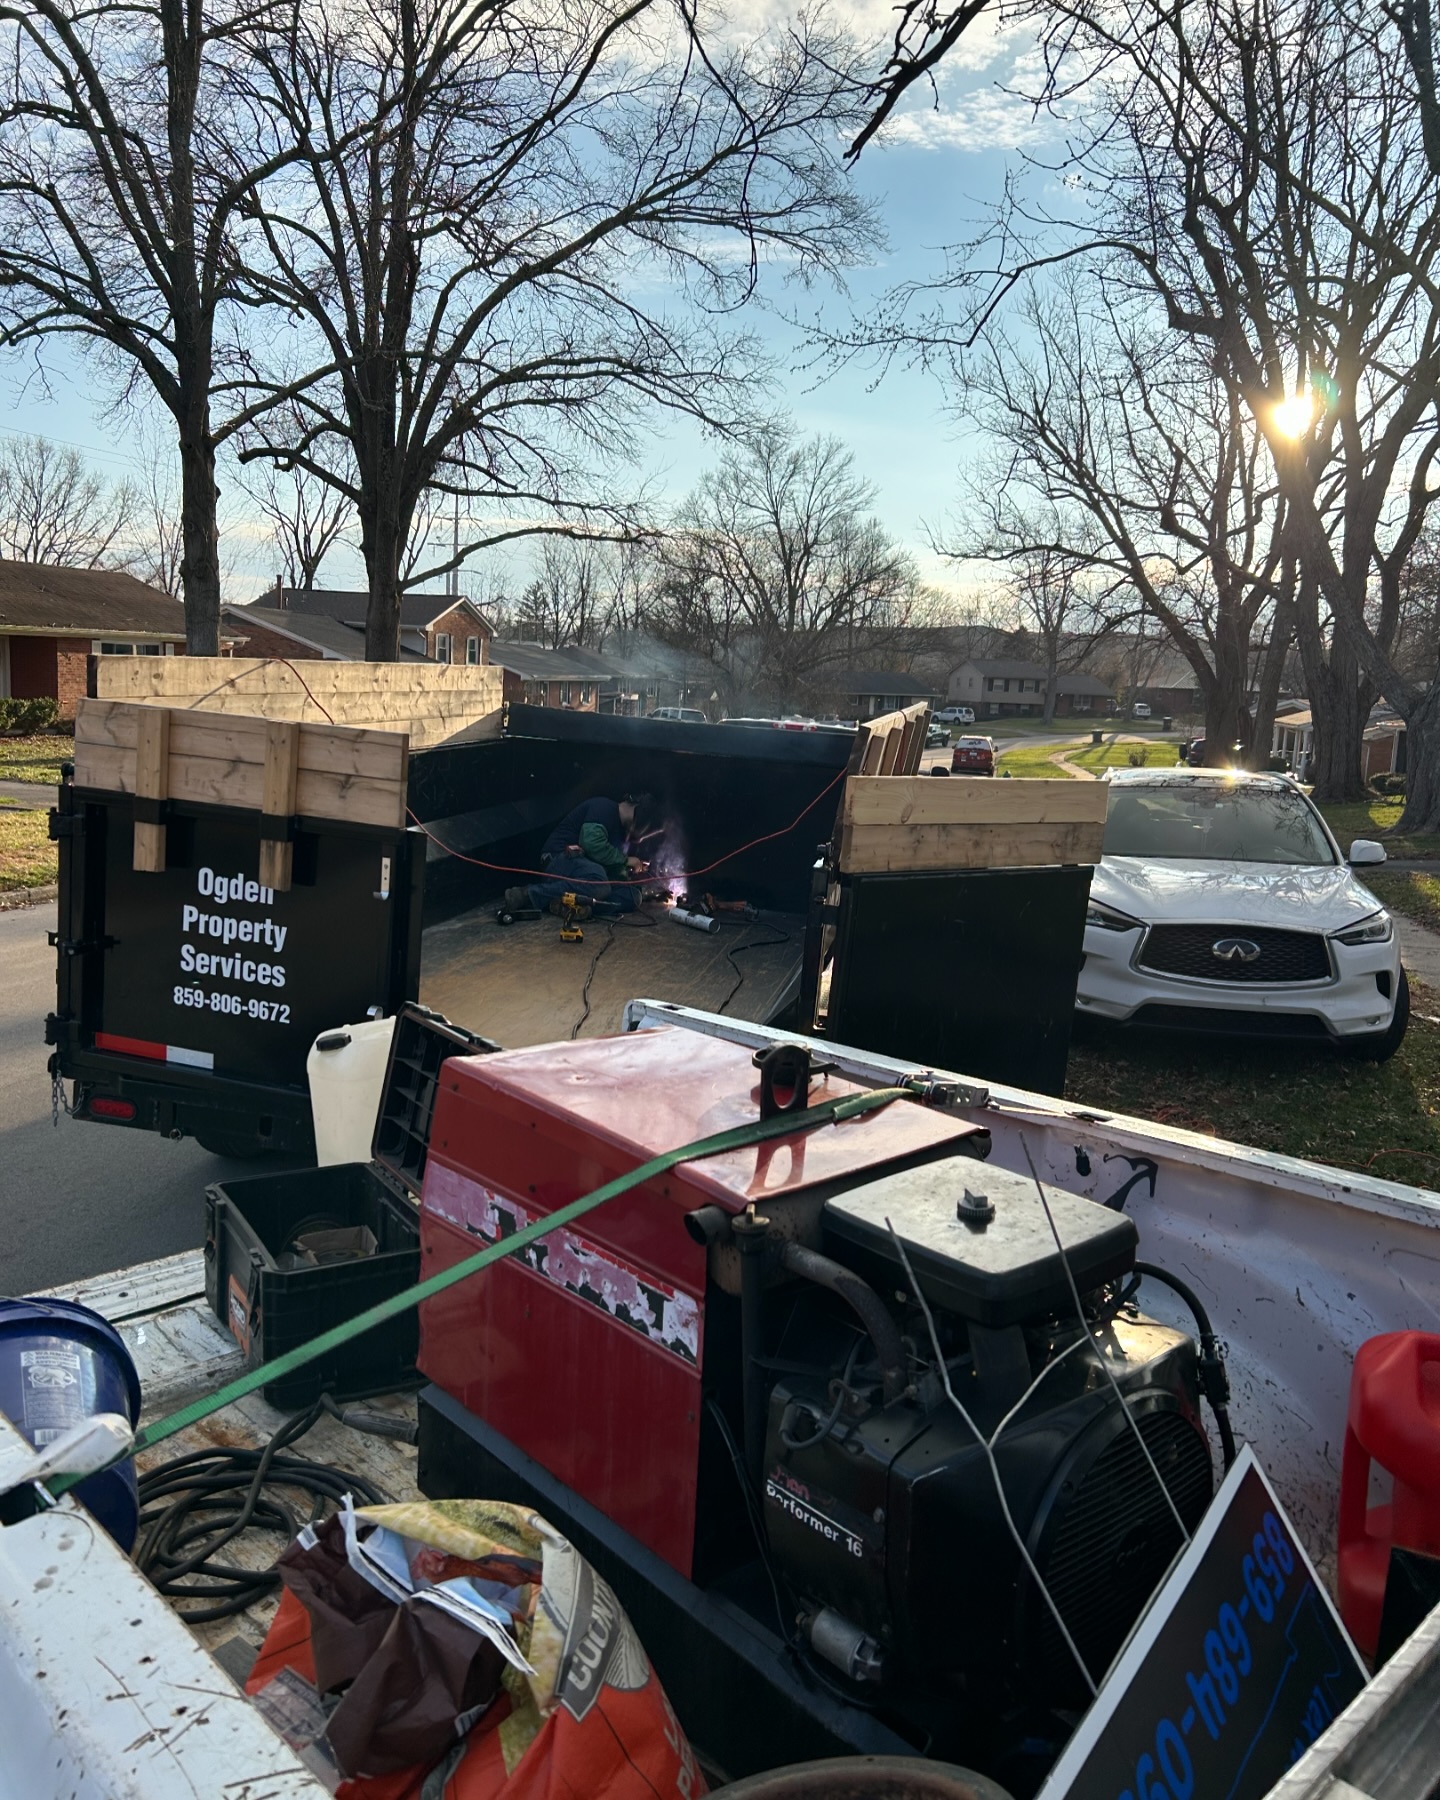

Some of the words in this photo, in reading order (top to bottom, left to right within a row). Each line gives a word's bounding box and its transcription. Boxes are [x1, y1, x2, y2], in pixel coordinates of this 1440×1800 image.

[198, 867, 274, 905] Ogden
[182, 904, 288, 952] Property
[180, 944, 286, 987] Services
[173, 986, 291, 1024] 859-806-9672
[845, 1536, 863, 1558] 16
[1118, 1511, 1295, 1800] 859-684-09
